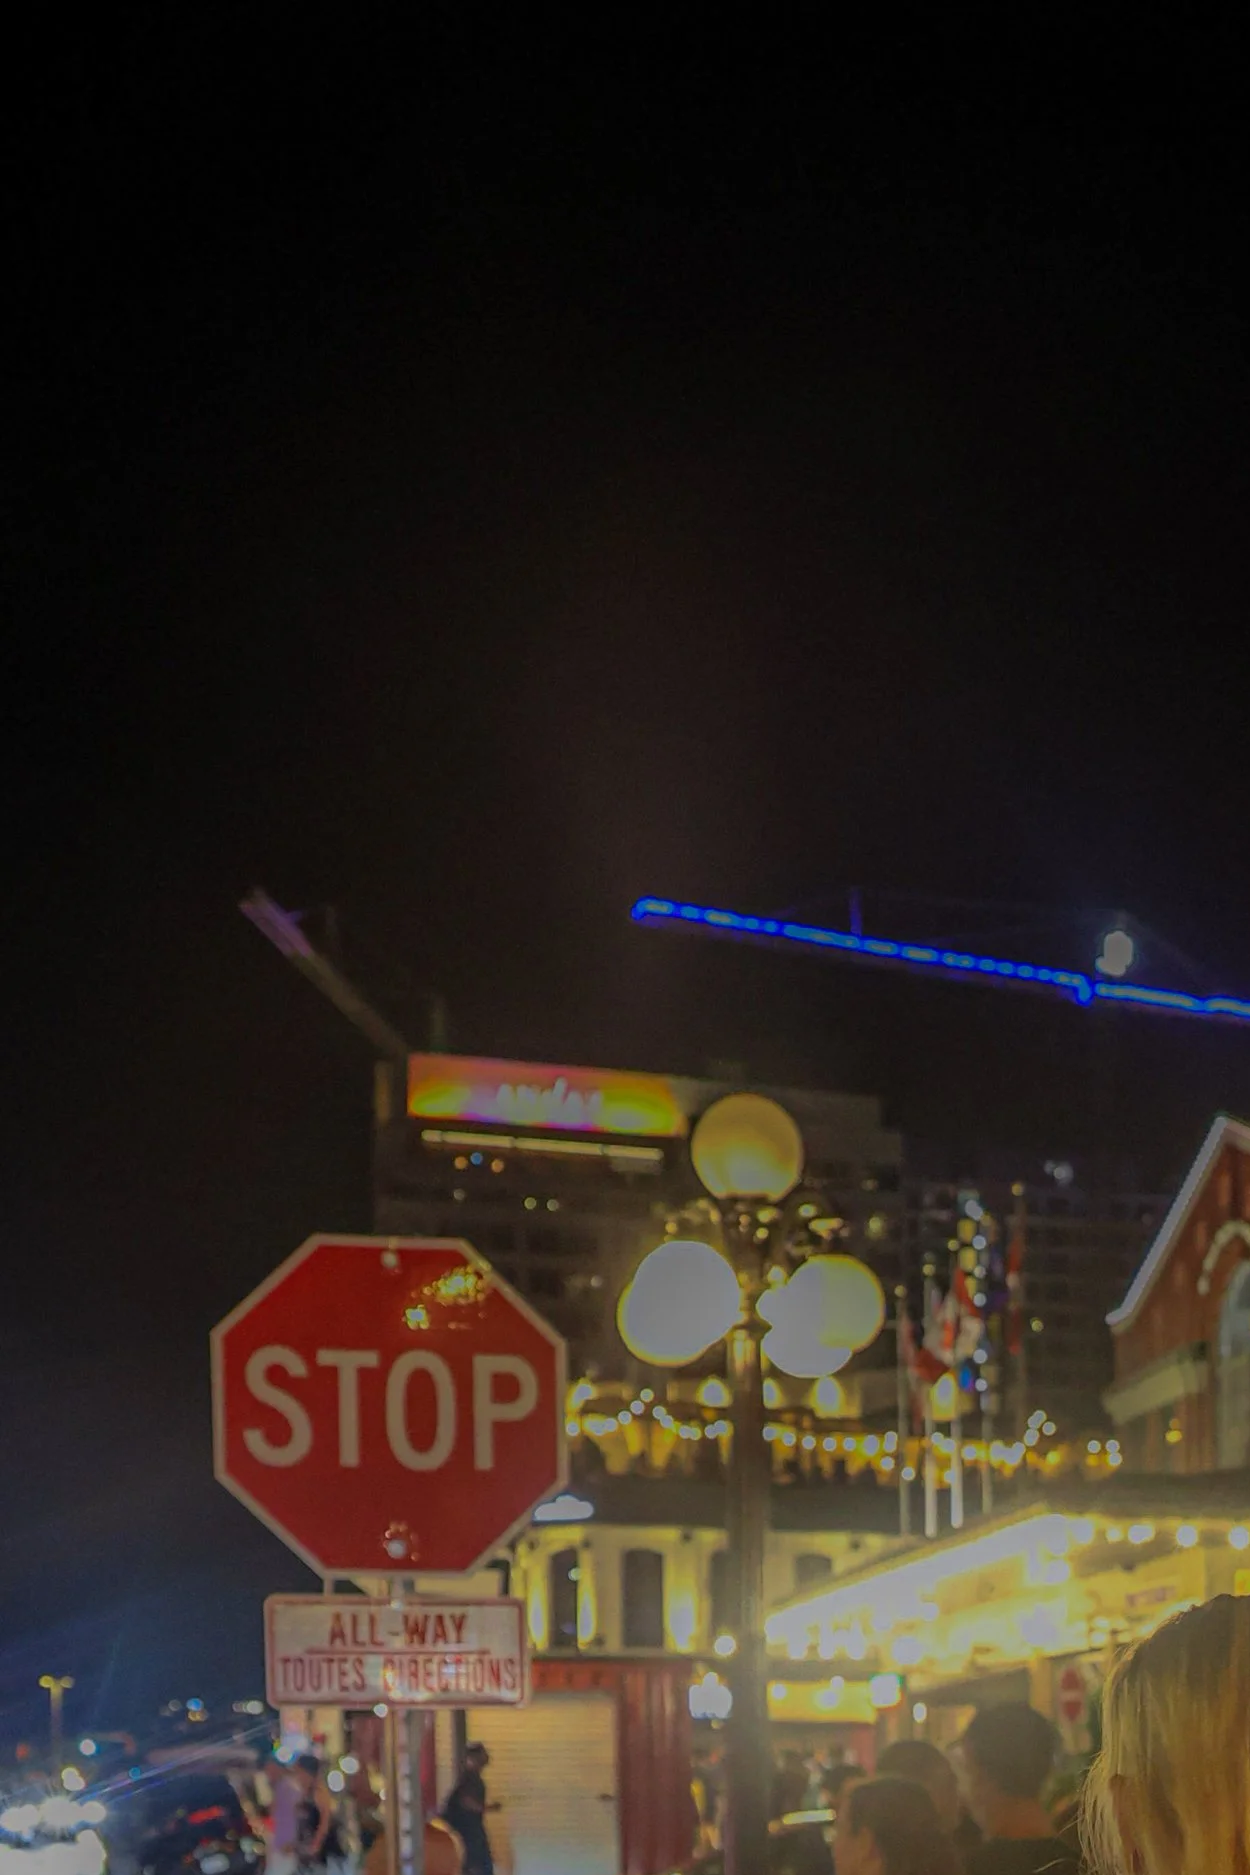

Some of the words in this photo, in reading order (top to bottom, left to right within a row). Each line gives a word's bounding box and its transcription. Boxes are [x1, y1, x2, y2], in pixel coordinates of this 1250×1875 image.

[243, 1344, 539, 1472] STOP
[329, 1612, 467, 1647] ALL-WAY
[281, 1656, 367, 1692] TOUTES
[382, 1655, 517, 1693] DIRECTIONS
